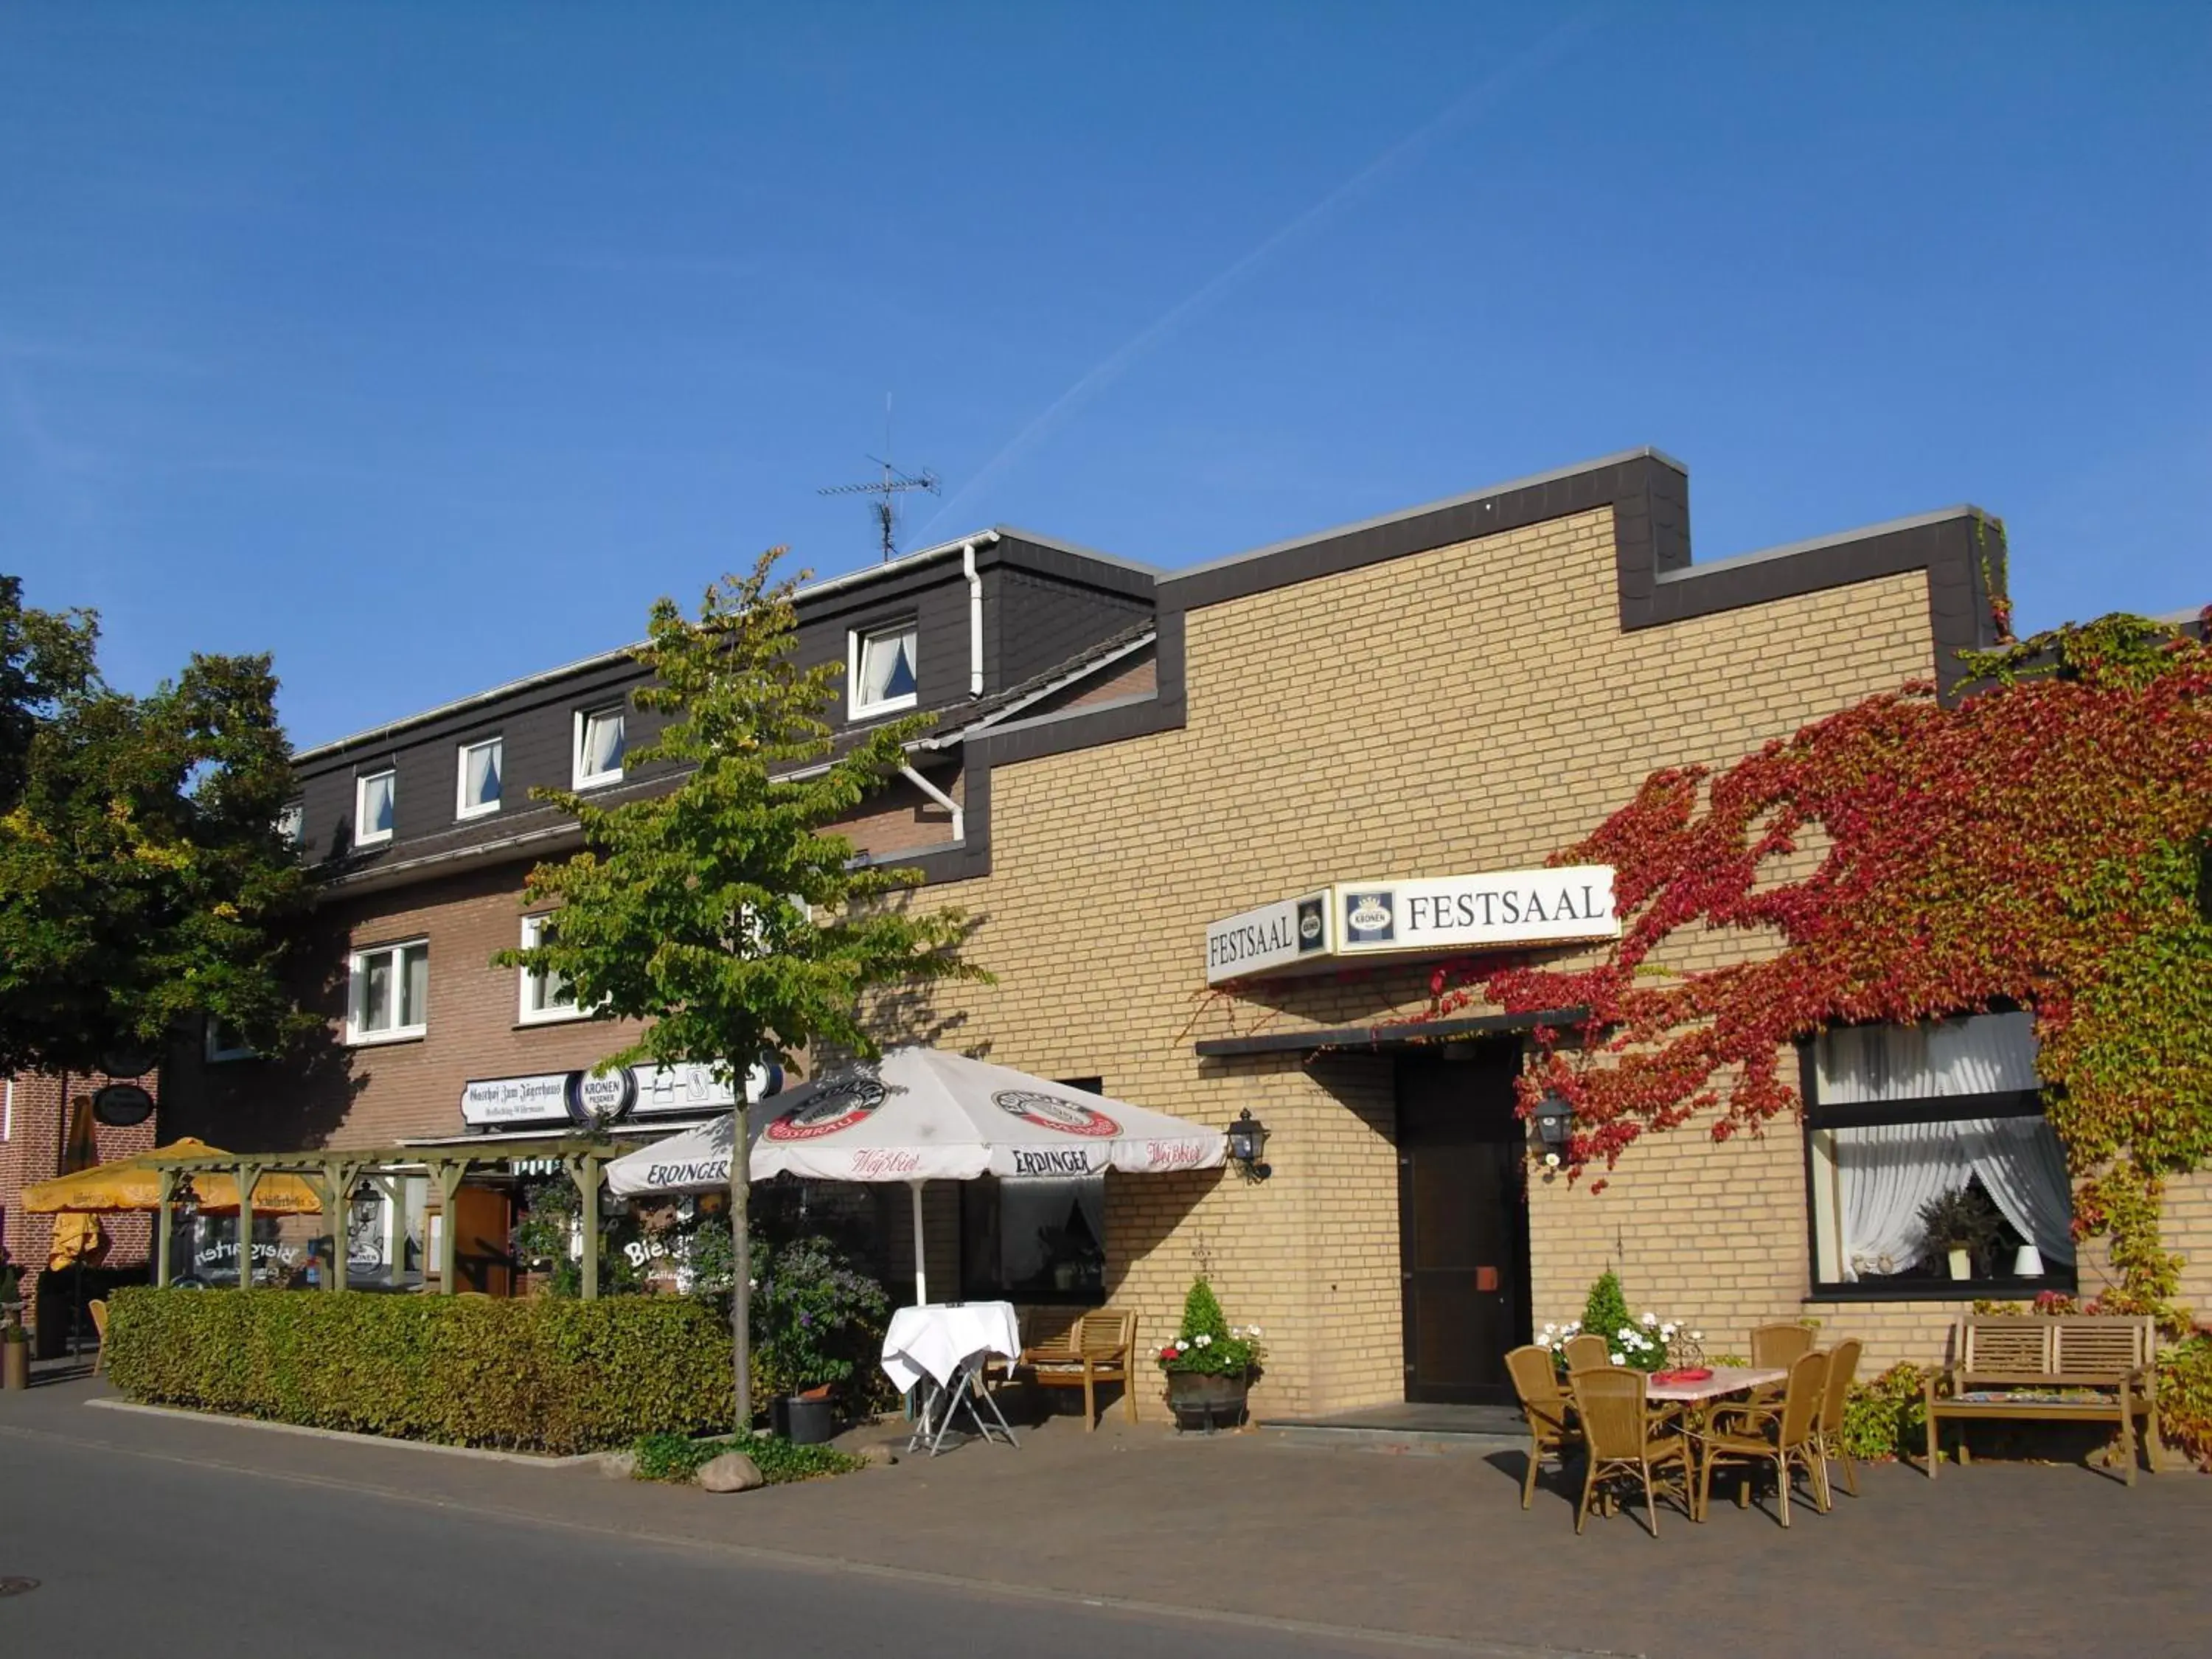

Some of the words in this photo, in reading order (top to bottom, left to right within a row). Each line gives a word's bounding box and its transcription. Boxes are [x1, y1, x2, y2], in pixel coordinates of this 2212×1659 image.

[1354, 913, 1385, 922] KRONEN
[1408, 884, 1606, 931] FESTSAAL
[1210, 914, 1295, 968] FESTSAAL
[585, 1080, 620, 1093] KRONEN
[647, 1159, 729, 1183] ERDINGER
[1013, 1150, 1089, 1175] ERDINGER
